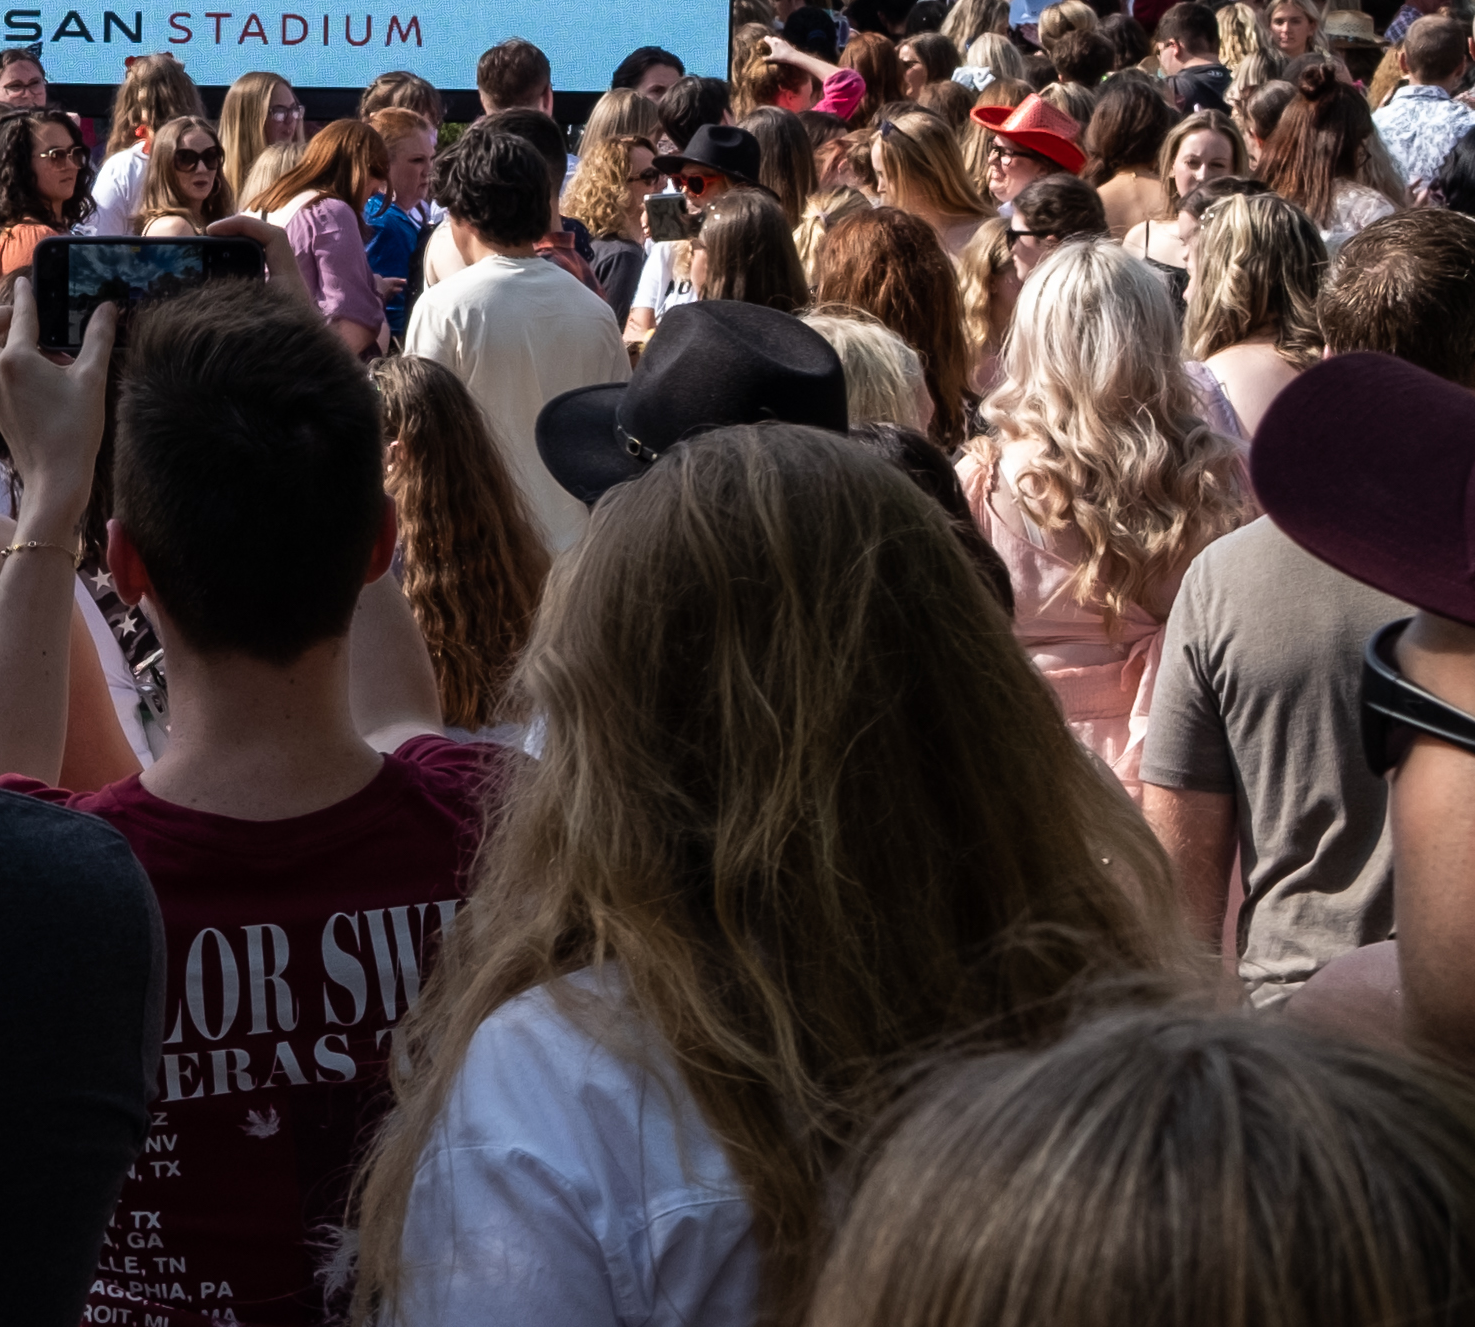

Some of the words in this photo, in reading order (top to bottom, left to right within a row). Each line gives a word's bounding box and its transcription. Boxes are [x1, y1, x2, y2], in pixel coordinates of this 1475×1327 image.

[168, 10, 425, 48] STADIUM
[160, 1032, 358, 1104] ERAS
[151, 1112, 169, 1125] Z
[145, 1134, 178, 1154] NV
[150, 1160, 182, 1178] TX
[131, 1211, 163, 1229] TX
[127, 1232, 165, 1249] GA
[153, 1257, 187, 1274] TN
[200, 1281, 234, 1299] PA
[83, 1304, 138, 1327] ROIT,
